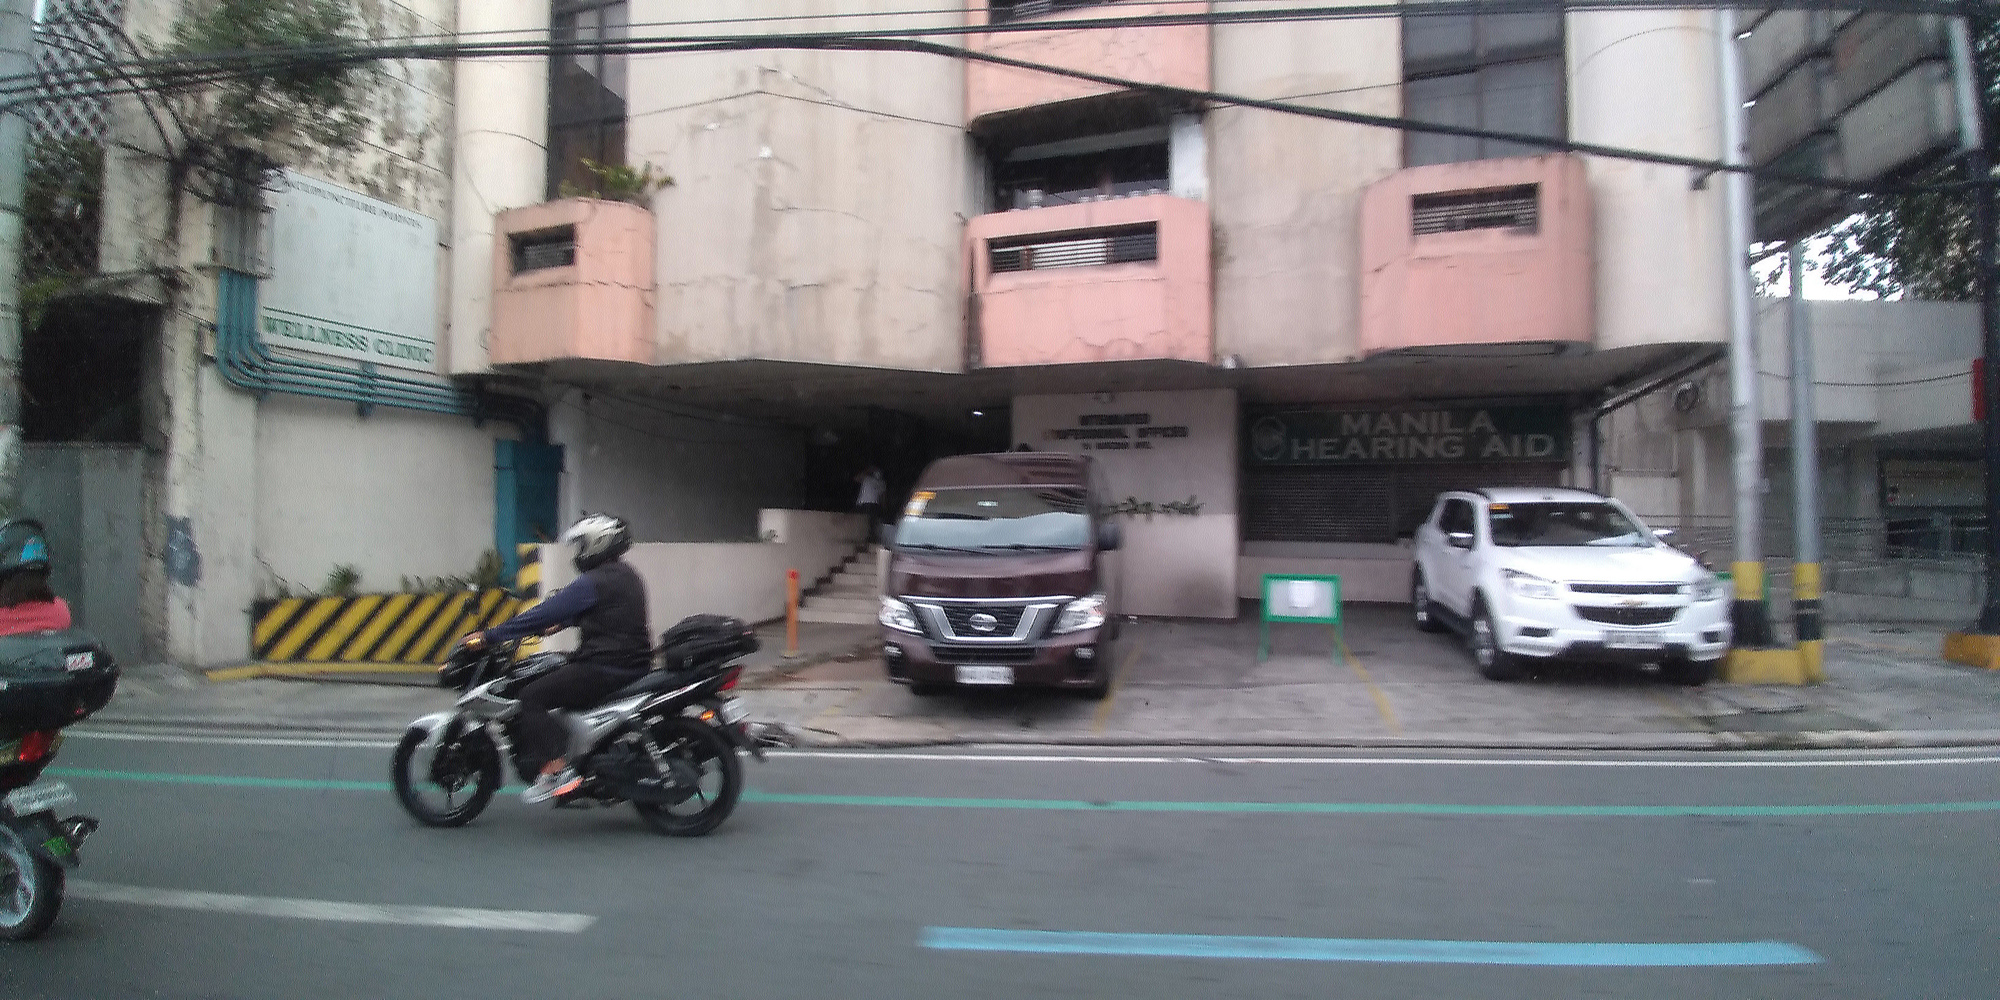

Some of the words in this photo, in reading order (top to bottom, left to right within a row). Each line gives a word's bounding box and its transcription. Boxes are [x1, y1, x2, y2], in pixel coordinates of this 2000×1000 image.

[262, 315, 368, 352] WELLNESS
[372, 337, 435, 364] CLINIC
[1341, 410, 1498, 436] MANILA
[1291, 435, 1466, 460] HEARING
[1480, 433, 1557, 458] AID
